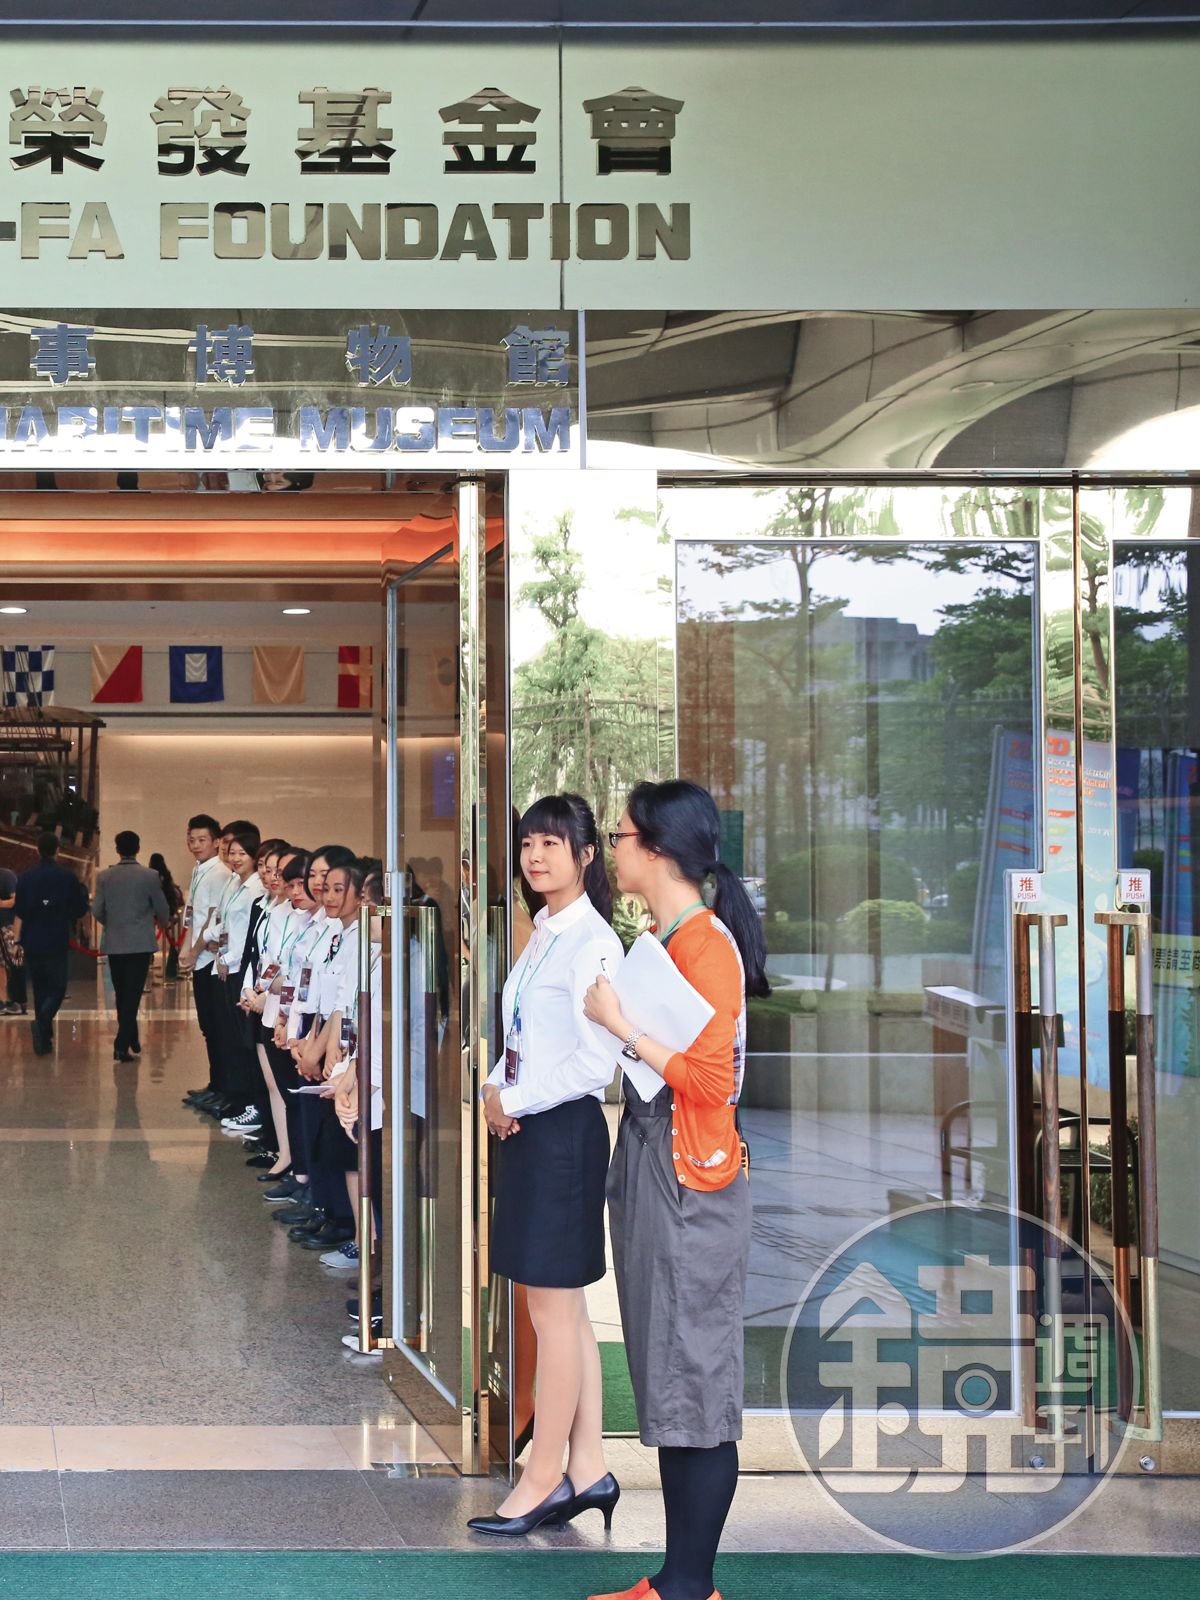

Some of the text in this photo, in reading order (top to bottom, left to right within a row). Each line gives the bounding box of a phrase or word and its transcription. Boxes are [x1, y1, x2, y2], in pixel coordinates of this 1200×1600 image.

[159, 202, 691, 261] FOUNDATION
[299, 406, 571, 454] MUSEUM
[1019, 876, 1034, 892] 推
[1128, 876, 1143, 892] 推
[1017, 891, 1037, 900] PUSH
[1125, 891, 1145, 900] PUSH
